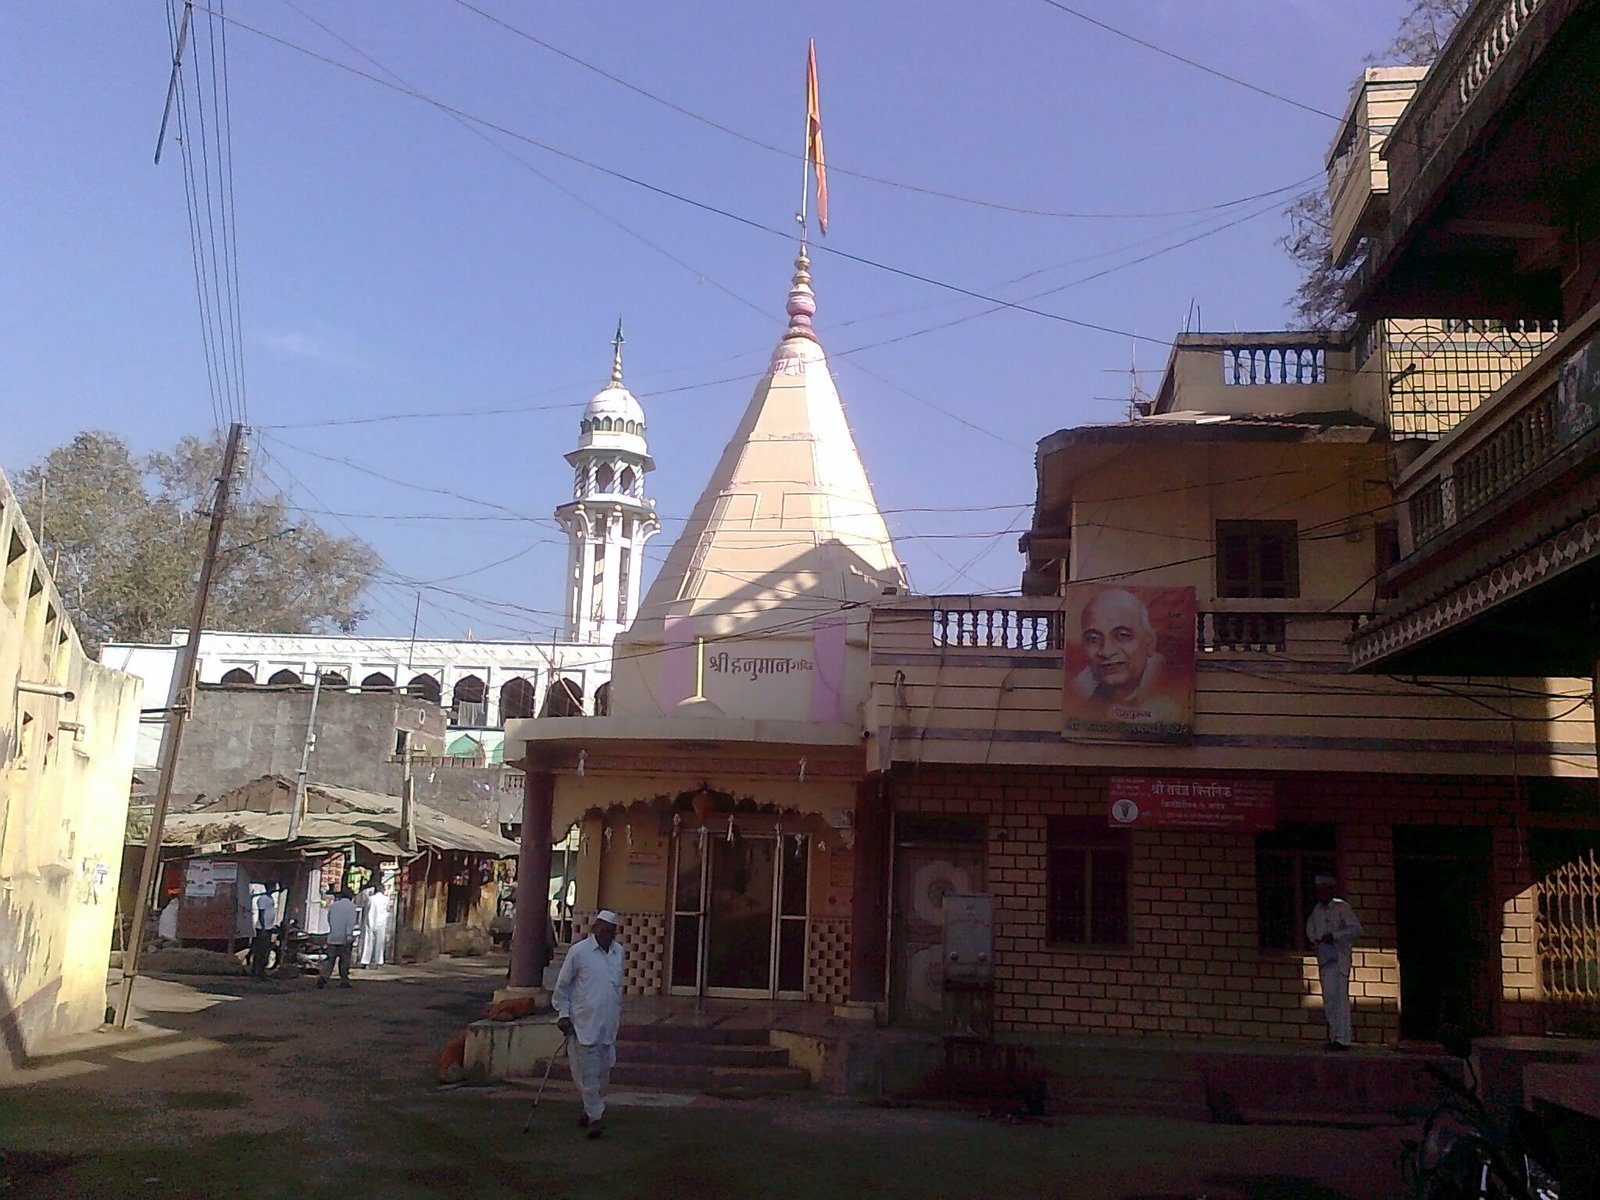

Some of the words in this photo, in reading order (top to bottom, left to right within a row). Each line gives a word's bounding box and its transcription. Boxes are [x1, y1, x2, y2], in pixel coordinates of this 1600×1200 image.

[709, 652, 729, 673] श्री
[731, 657, 792, 681] हनुमान
[1151, 780, 1164, 795] श्री
